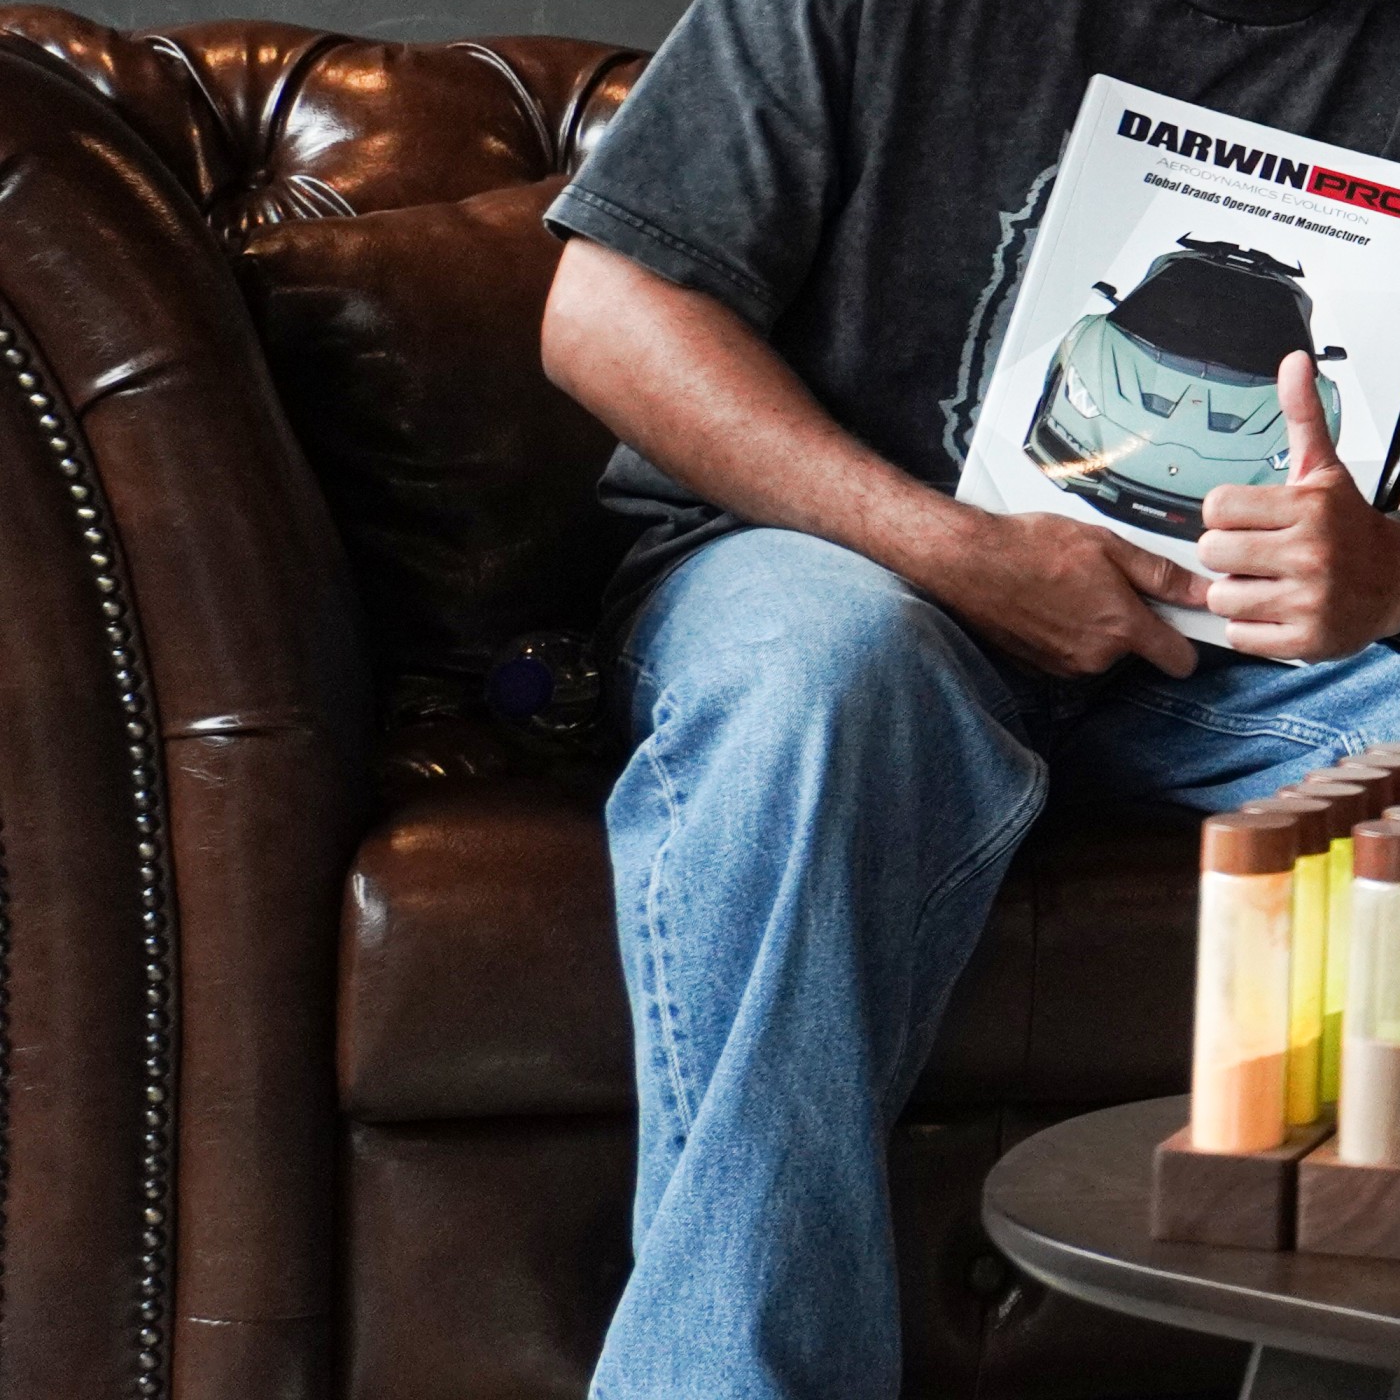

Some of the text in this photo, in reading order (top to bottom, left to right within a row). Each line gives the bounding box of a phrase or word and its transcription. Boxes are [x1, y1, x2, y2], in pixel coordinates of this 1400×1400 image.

[1143, 172, 1371, 246] Global Brands Operator and Manufacturer
[1156, 157, 1370, 225] AERODYNAMICS EVOLUTION
